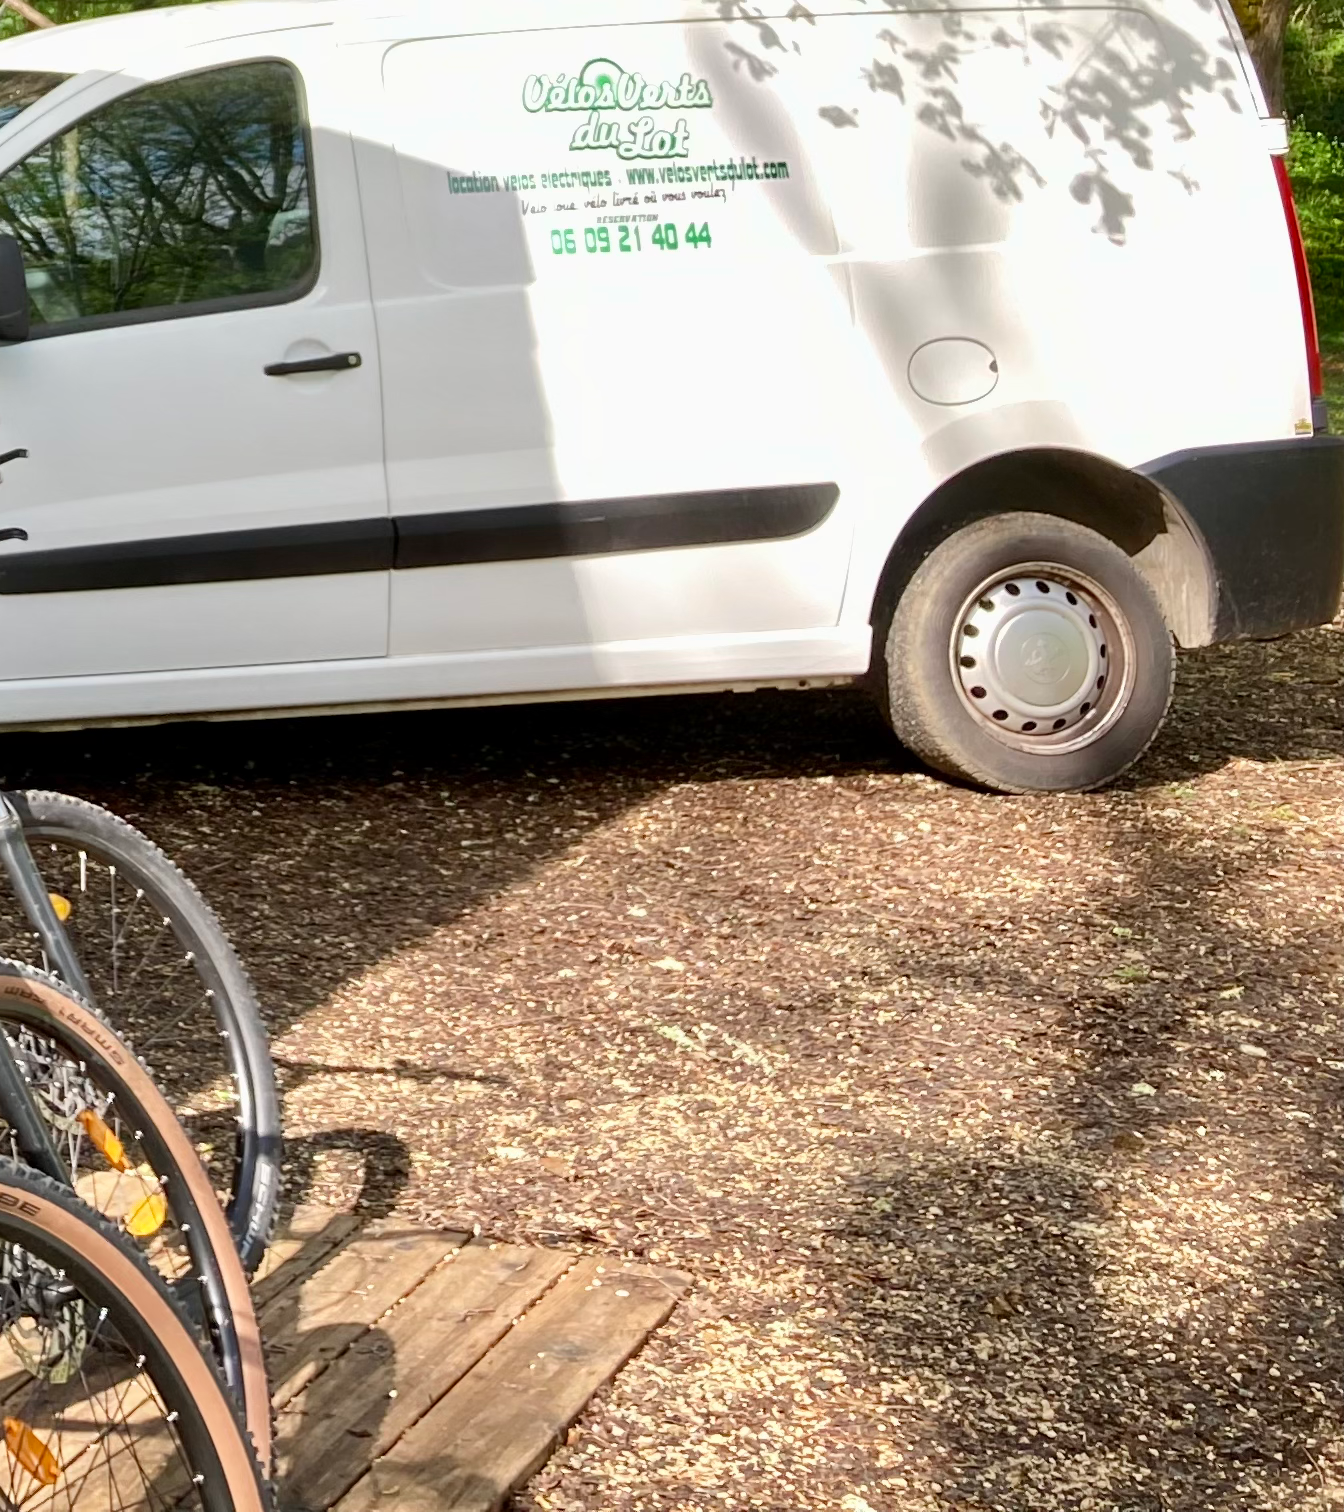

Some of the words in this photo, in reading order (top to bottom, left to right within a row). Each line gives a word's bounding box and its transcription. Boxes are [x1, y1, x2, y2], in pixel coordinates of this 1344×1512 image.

[522, 73, 616, 113] Vélos
[617, 72, 713, 110] Verts
[569, 110, 620, 151] du
[616, 115, 689, 160] Lot
[447, 170, 500, 194] location
[612, 191, 639, 206] livré
[662, 191, 686, 202] vous
[691, 183, 726, 203] voulez
[551, 229, 576, 254] 06
[584, 227, 610, 253] 09
[618, 225, 641, 252] 21
[652, 223, 678, 250] 40
[685, 222, 711, 248] 44
